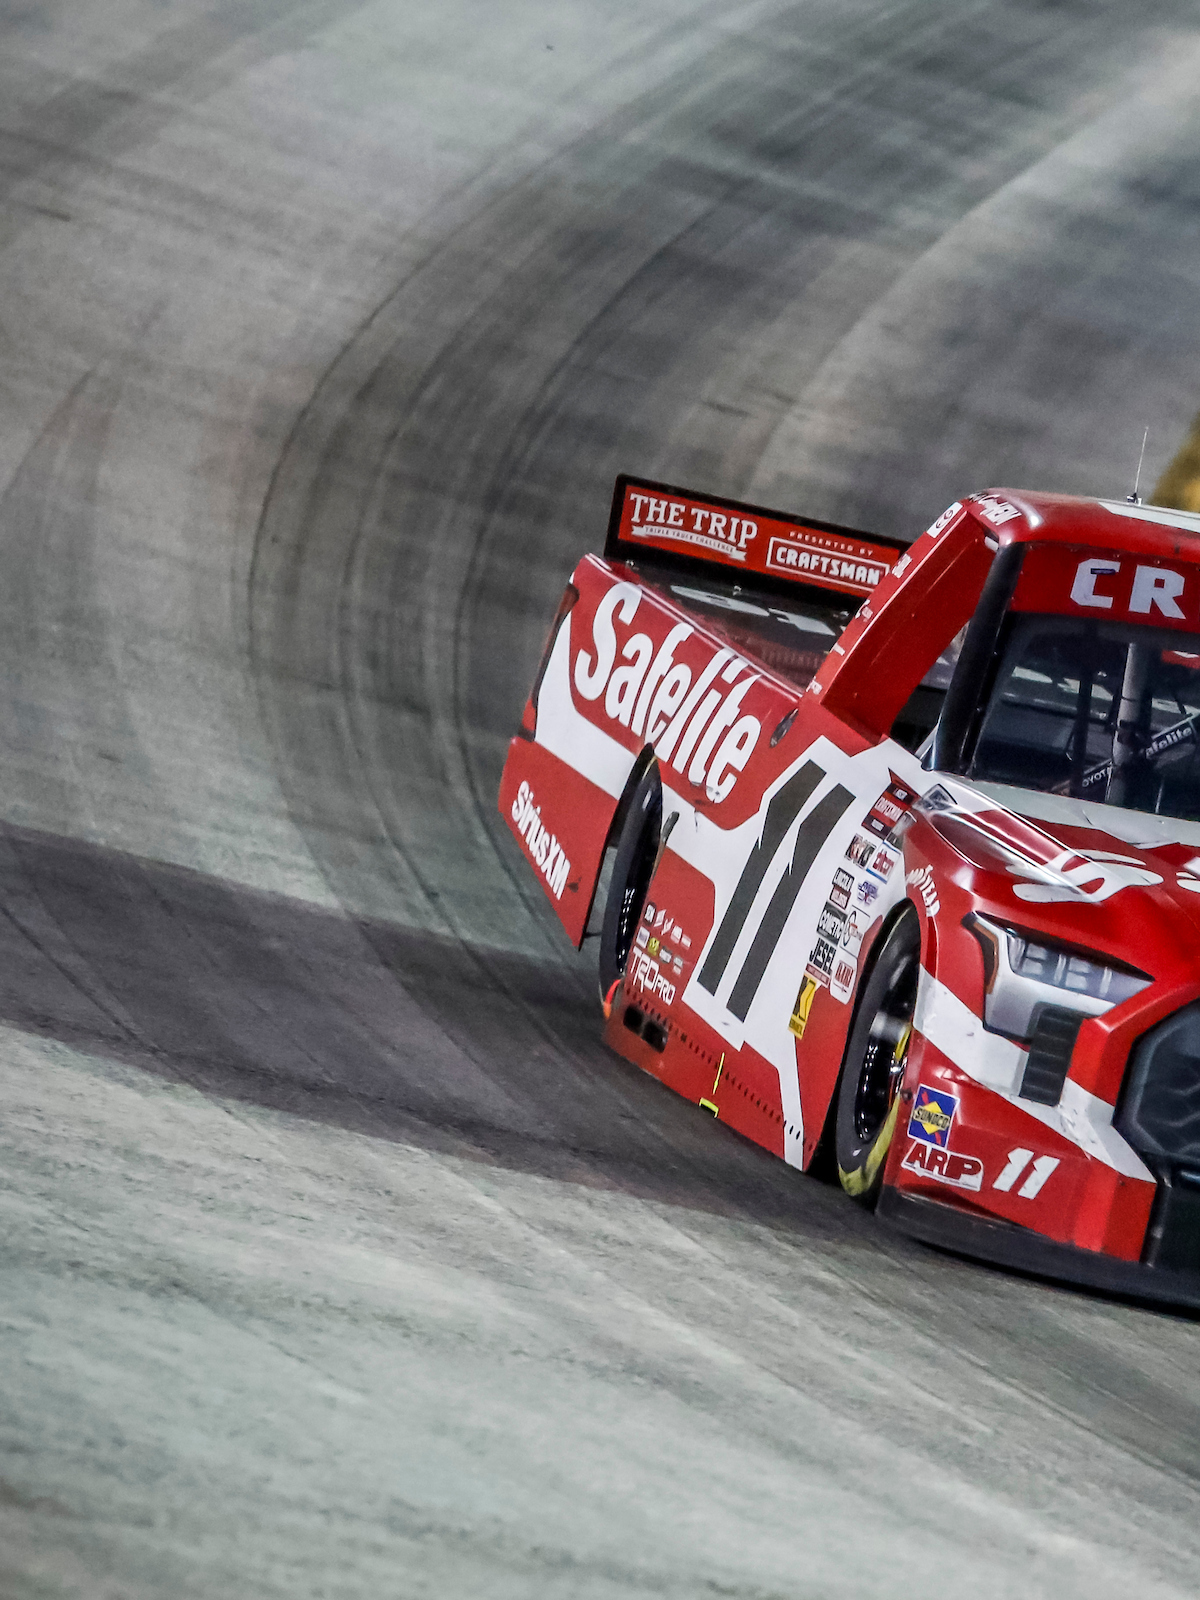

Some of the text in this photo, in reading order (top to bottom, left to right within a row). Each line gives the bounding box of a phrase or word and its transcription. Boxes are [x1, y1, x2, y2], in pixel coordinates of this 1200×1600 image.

[630, 493, 758, 549] THE TRIP
[789, 531, 874, 557] PRESENTED BY
[775, 546, 882, 586] CRAFTSMAN
[574, 580, 763, 804] Safelite
[1143, 725, 1194, 760] afelite
[511, 779, 571, 900] SiriusXM
[696, 758, 857, 1024] 11
[808, 937, 838, 977] JESEL
[914, 1108, 950, 1130] SUNOCO
[905, 1142, 983, 1182] ARP
[992, 1146, 1062, 1201] 11
